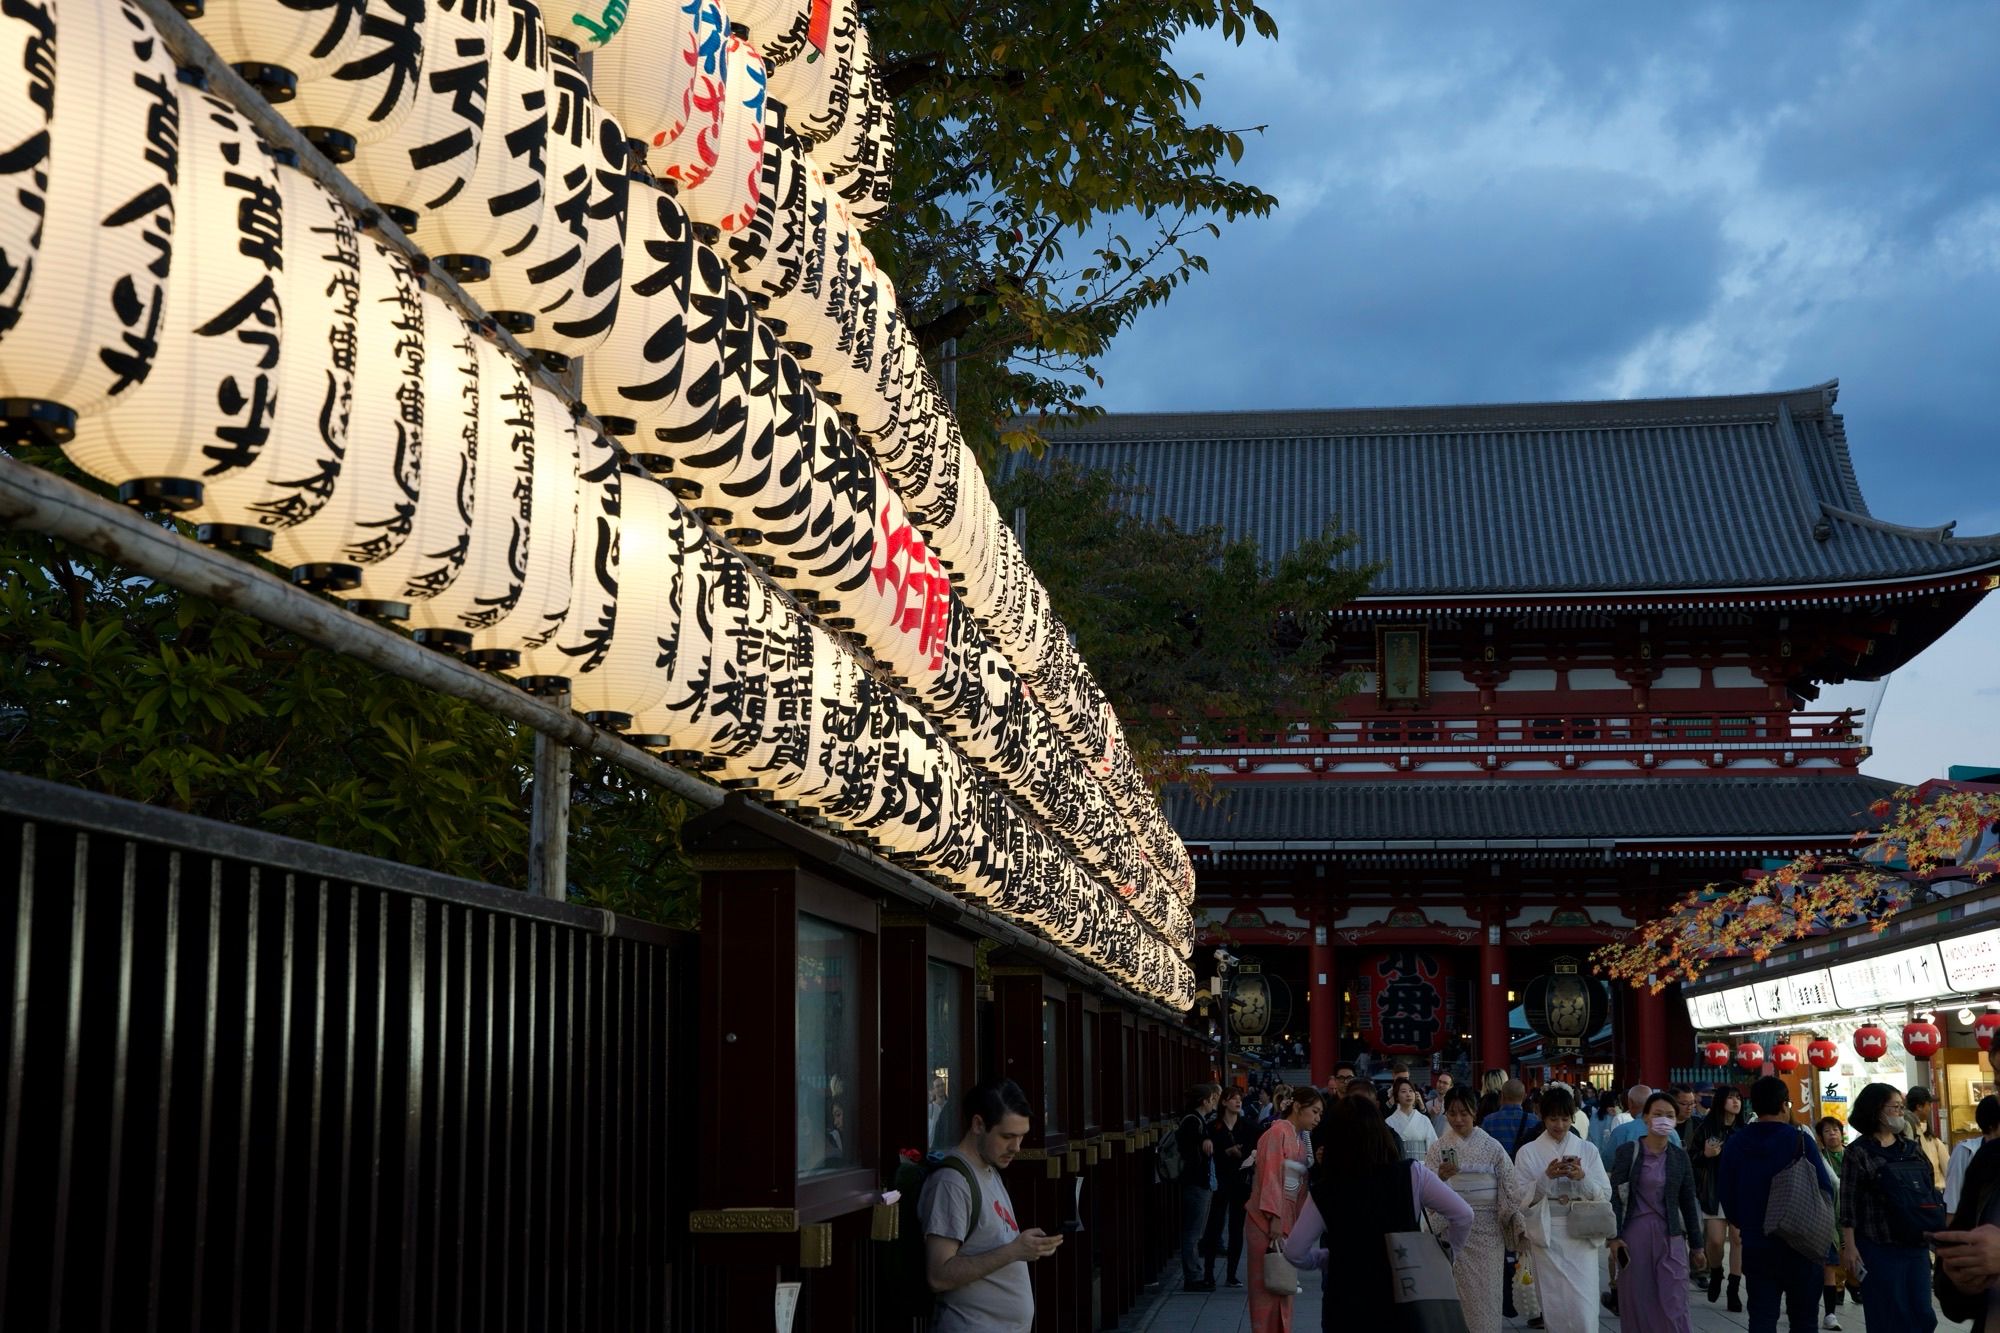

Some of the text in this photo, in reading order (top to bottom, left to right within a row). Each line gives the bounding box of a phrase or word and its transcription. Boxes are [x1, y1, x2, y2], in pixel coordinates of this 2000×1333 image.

[1378, 952, 1440, 1049] 小舟町
[1400, 1277, 1418, 1296] R
